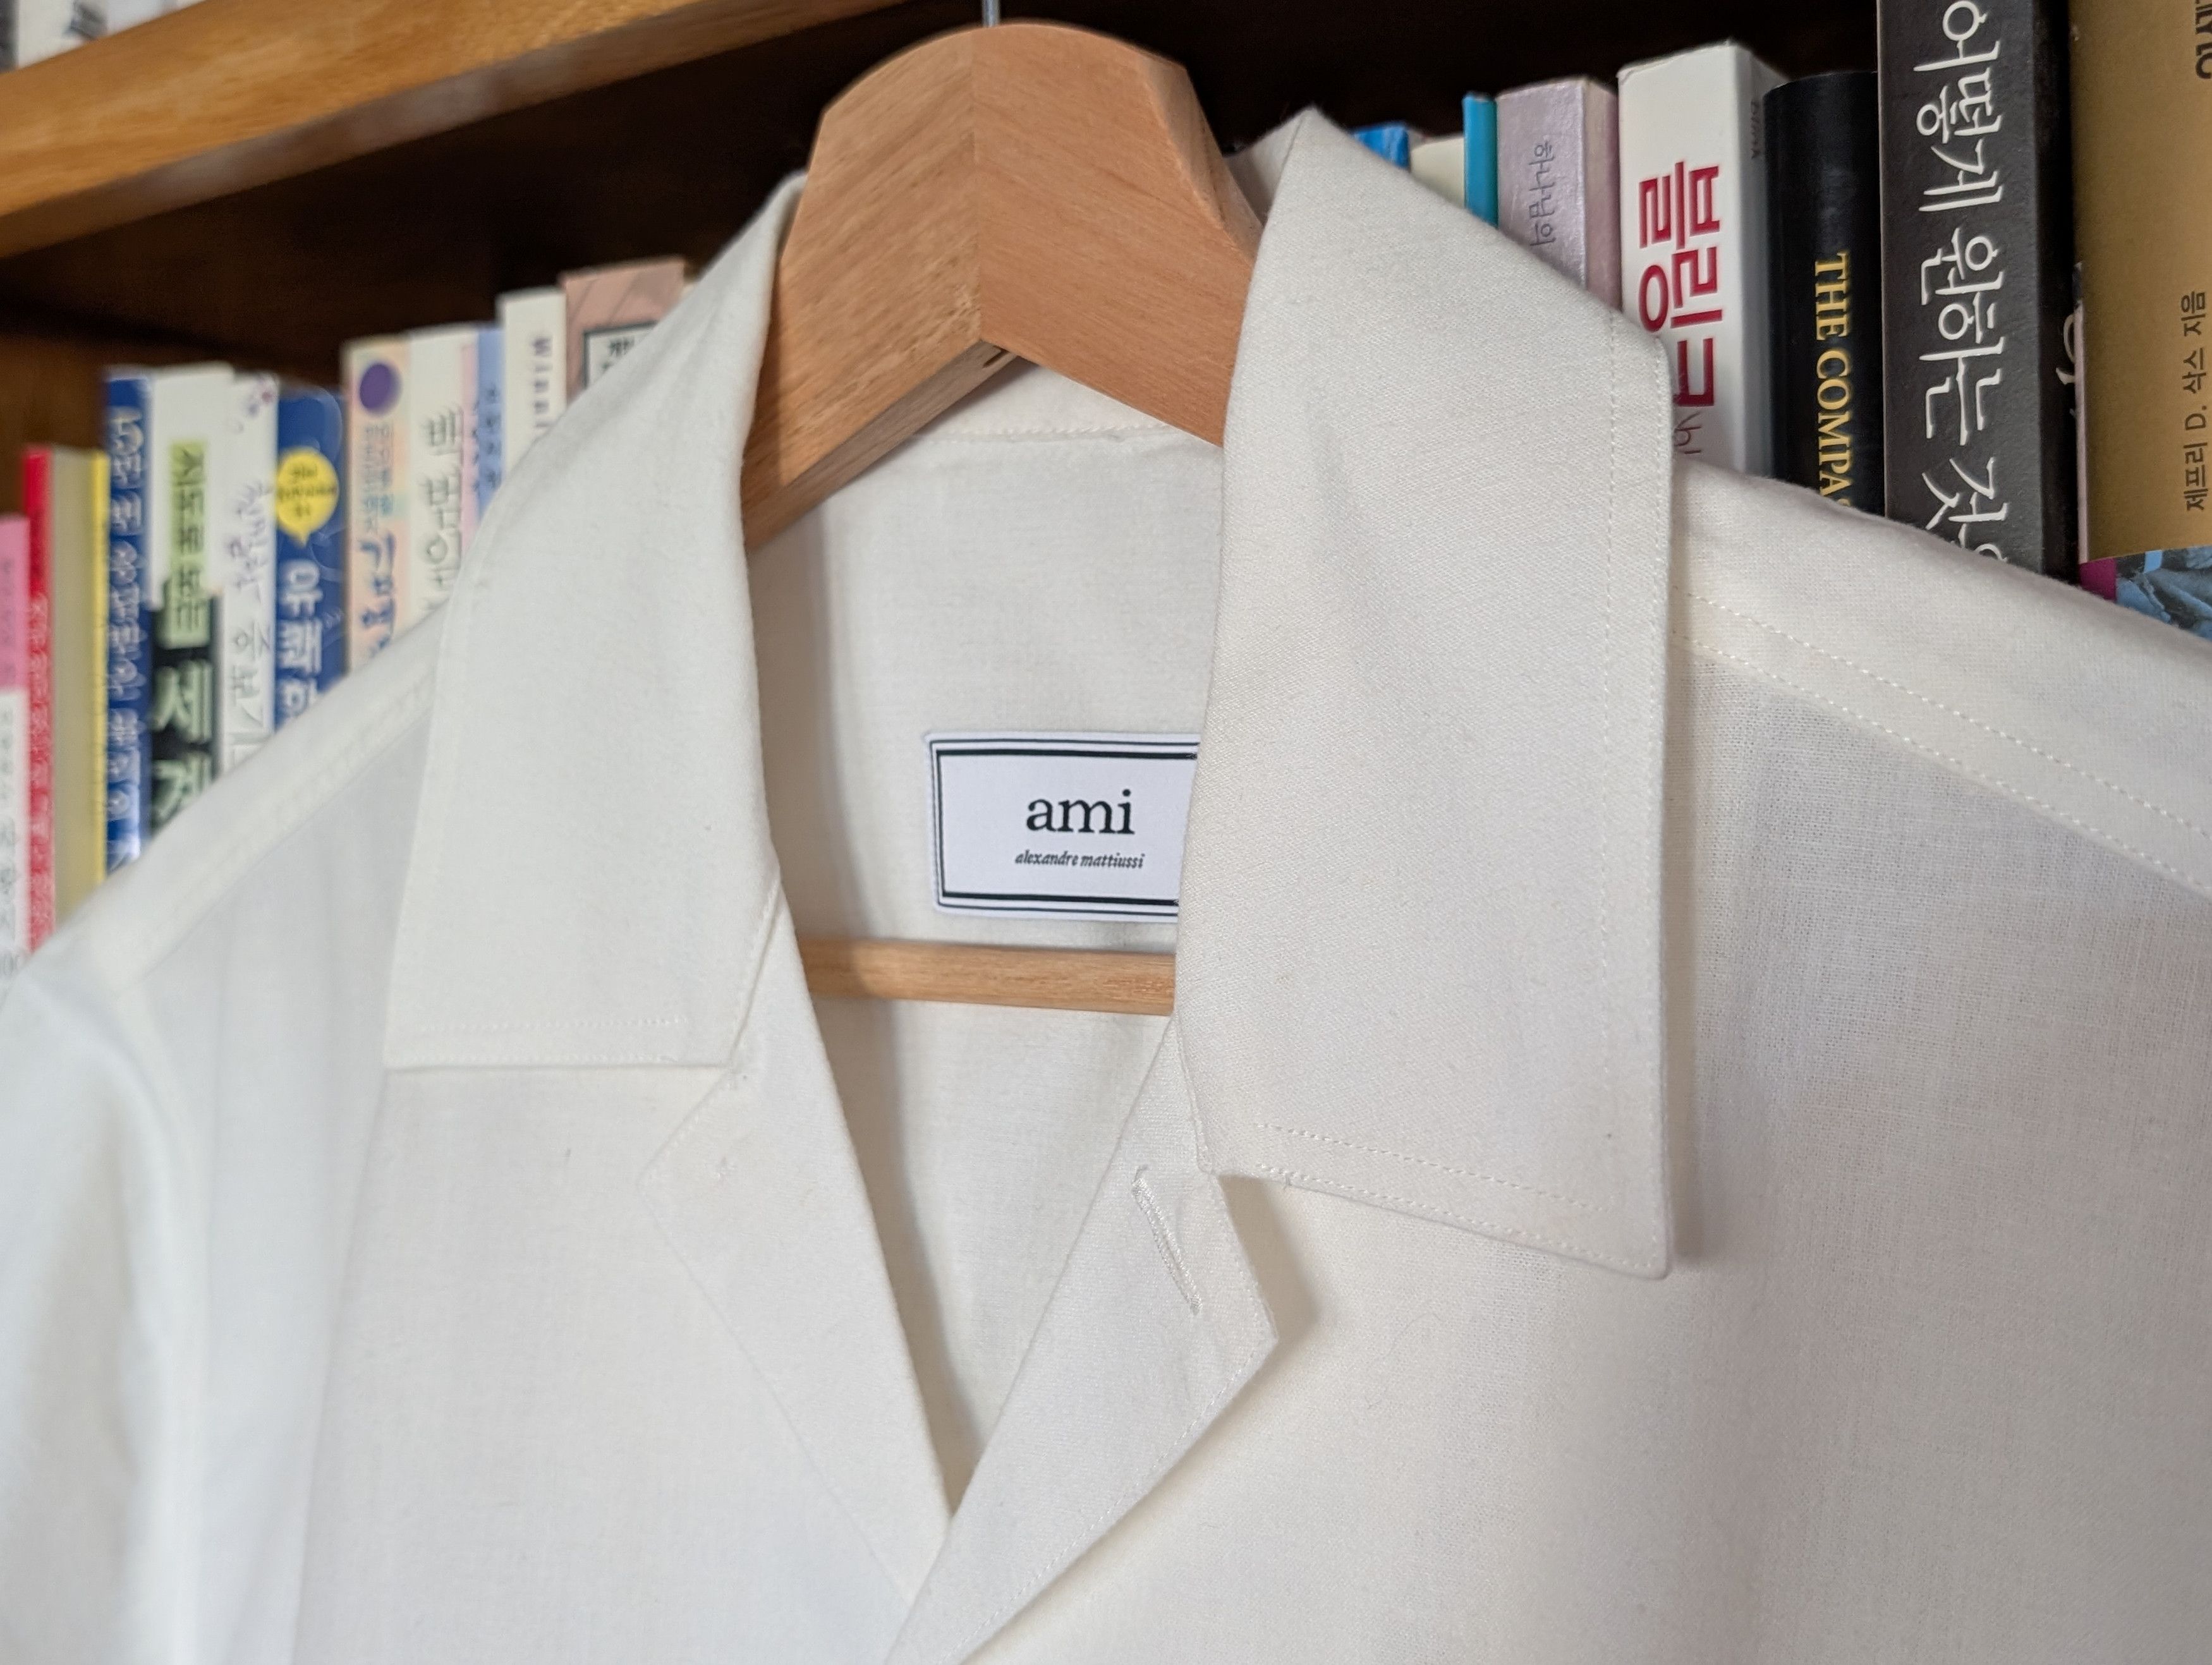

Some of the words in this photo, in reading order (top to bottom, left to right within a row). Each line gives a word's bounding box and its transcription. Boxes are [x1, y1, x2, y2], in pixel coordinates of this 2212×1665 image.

[1914, 0, 2004, 212] 어떻게
[1528, 141, 1557, 246] 하나님의
[1814, 253, 1849, 341] THE
[1919, 227, 2005, 446] 원하는
[2180, 290, 2205, 330] 지음
[2184, 345, 2207, 394] 삭스
[1816, 349, 1852, 506] COMPA
[2185, 404, 2206, 431] D.
[1921, 456, 2009, 562] 것
[2184, 439, 2208, 511] 제프리
[1026, 788, 1135, 835] ami
[1014, 849, 1079, 867] alexandre
[1080, 852, 1146, 870] mattiussi
